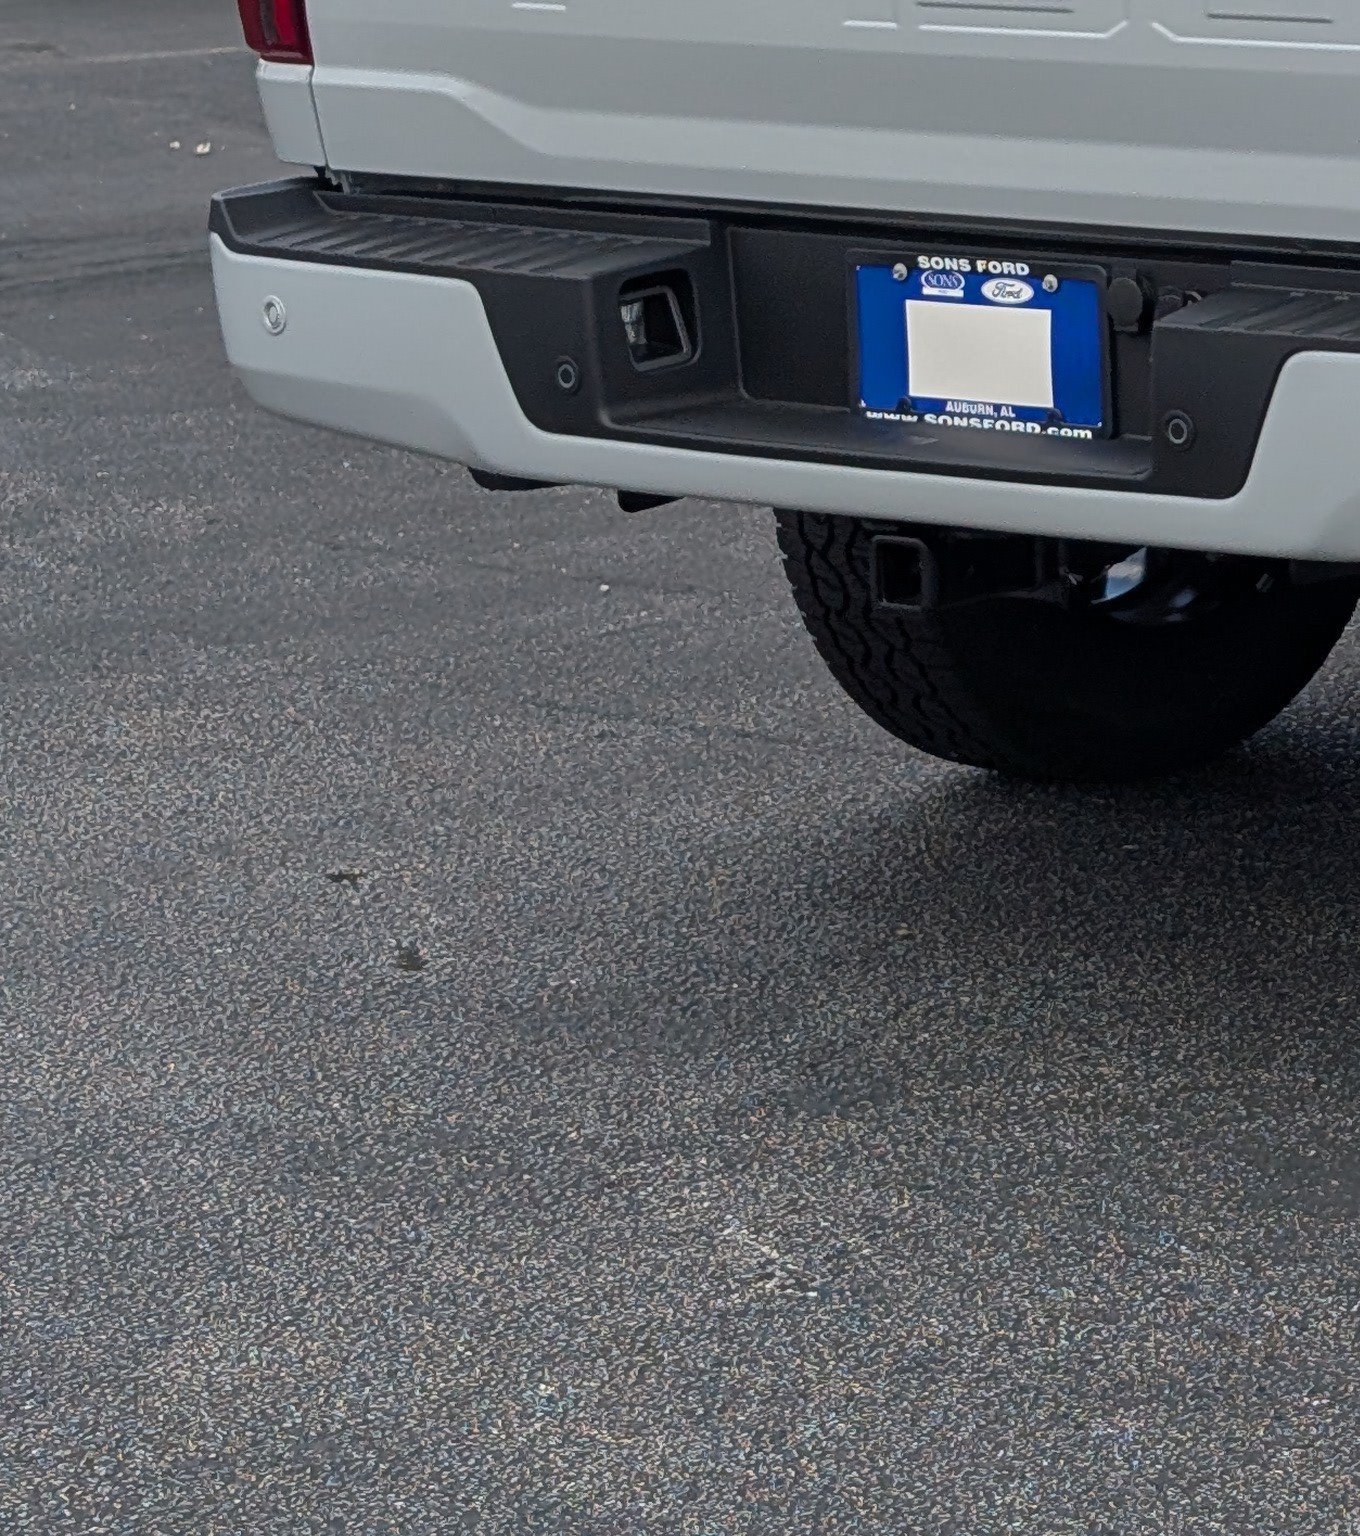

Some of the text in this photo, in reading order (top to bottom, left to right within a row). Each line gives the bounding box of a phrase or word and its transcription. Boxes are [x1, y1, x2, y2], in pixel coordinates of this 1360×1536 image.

[917, 255, 1030, 276] SONS FORD
[928, 273, 959, 288] SONS
[992, 282, 1023, 299] Ford
[945, 400, 1016, 418] AUBURN, AL
